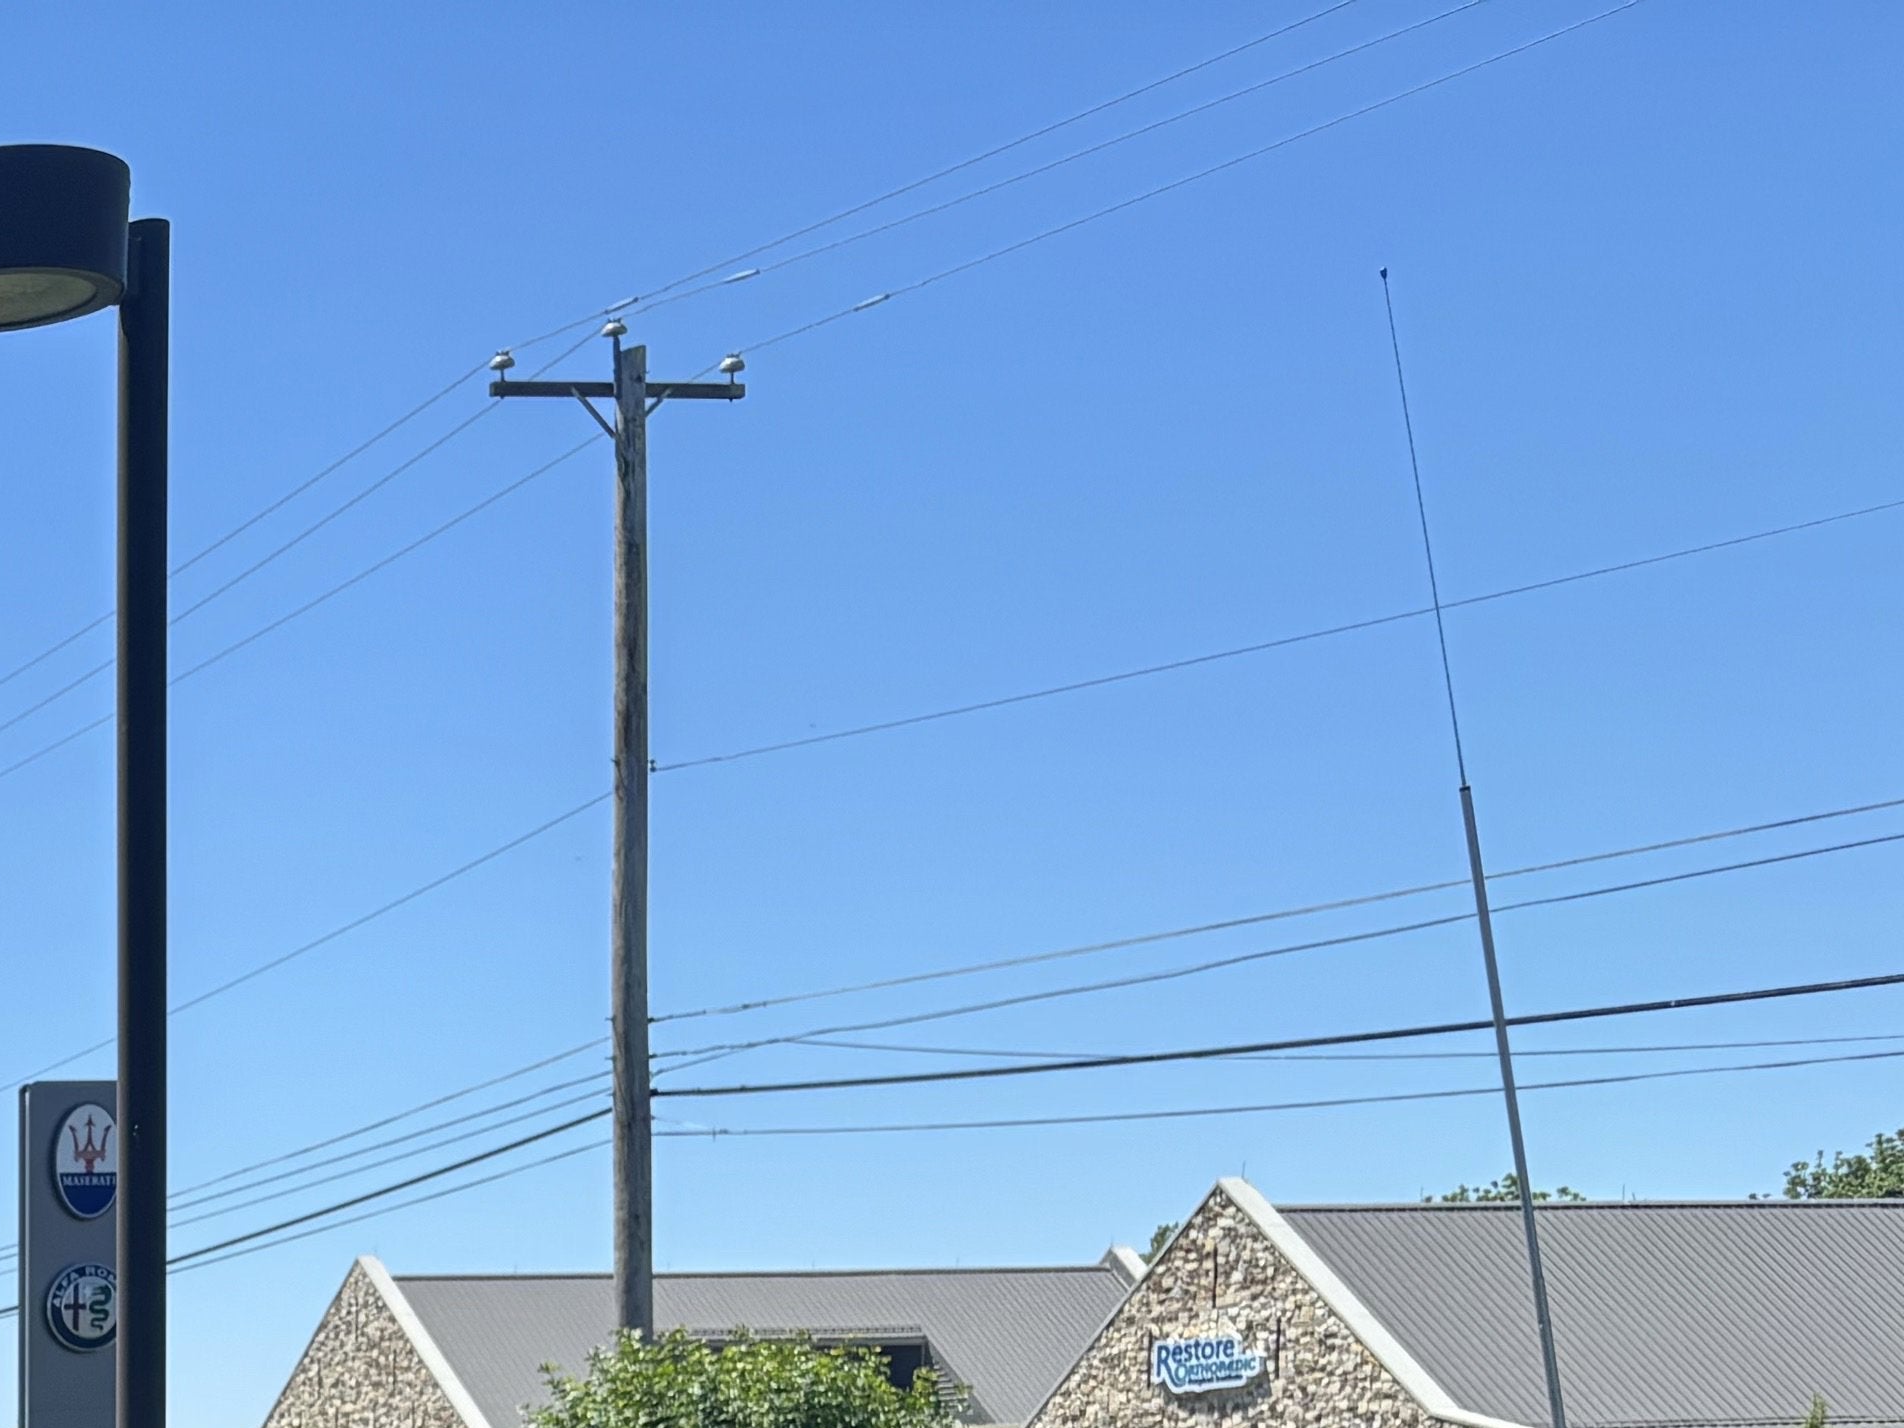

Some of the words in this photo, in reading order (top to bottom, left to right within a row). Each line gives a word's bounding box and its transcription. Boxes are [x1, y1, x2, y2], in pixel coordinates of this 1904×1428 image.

[62, 1175, 116, 1186] MASERATI
[52, 1271, 81, 1308] ALFA
[1156, 1339, 1235, 1387] Restore
